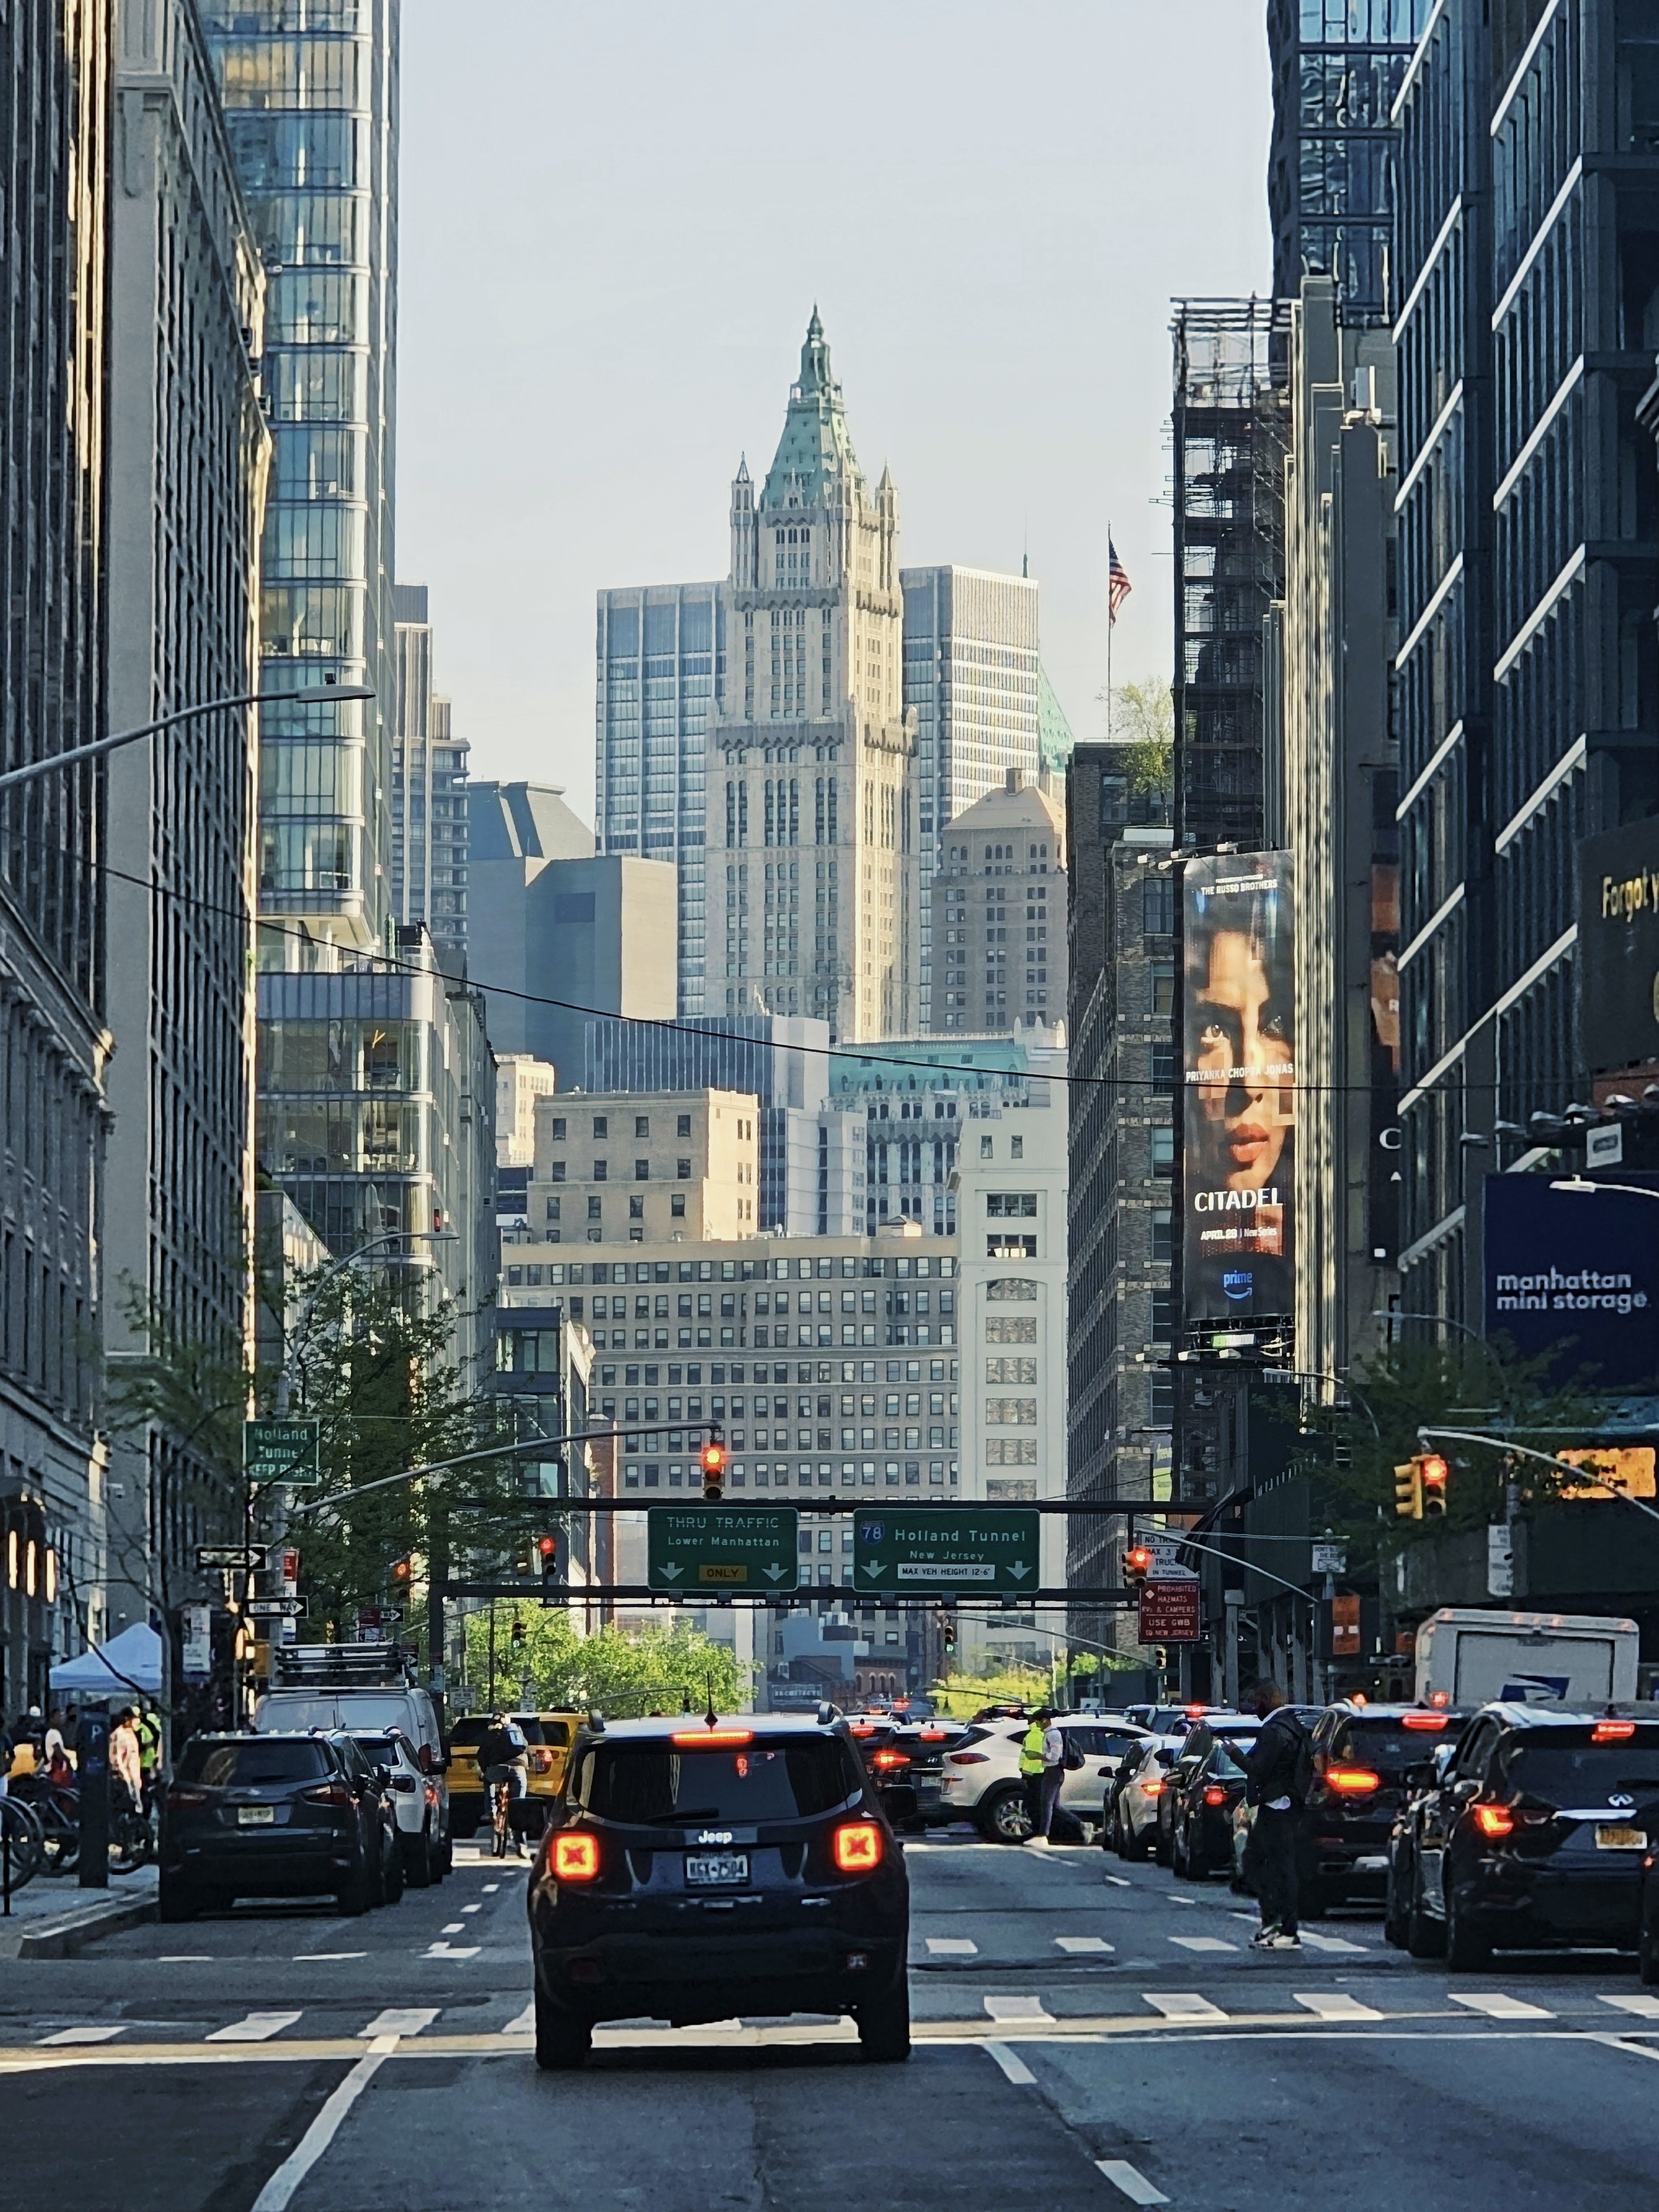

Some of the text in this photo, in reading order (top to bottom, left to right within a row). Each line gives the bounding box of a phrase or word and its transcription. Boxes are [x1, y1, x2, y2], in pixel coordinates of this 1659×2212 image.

[1201, 879, 1277, 895] THE RUSSO BROTHERS
[1186, 1063, 1293, 1082] PRIYANKA CHOPRA JONAS
[1194, 1187, 1284, 1212] CITADEL
[1201, 1230, 1225, 1240] APRIL
[1225, 1229, 1238, 1239] 28
[1258, 1227, 1277, 1236] Series
[1224, 1270, 1253, 1287] prime
[1496, 1264, 1632, 1291] manhattan
[1496, 1291, 1648, 1314] mini storage
[255, 1428, 307, 1441] Holland
[667, 1516, 779, 1528] THRU TRAFFIC
[863, 1526, 882, 1540] 78
[895, 1529, 1025, 1542] Holland Tunnel
[668, 1536, 779, 1546] Lower Manhattan
[910, 1551, 985, 1562] New Jersey
[706, 1569, 739, 1578] ONLY
[253, 1602, 298, 1613] ONE WAY
[698, 1830, 733, 1844] Jeep
